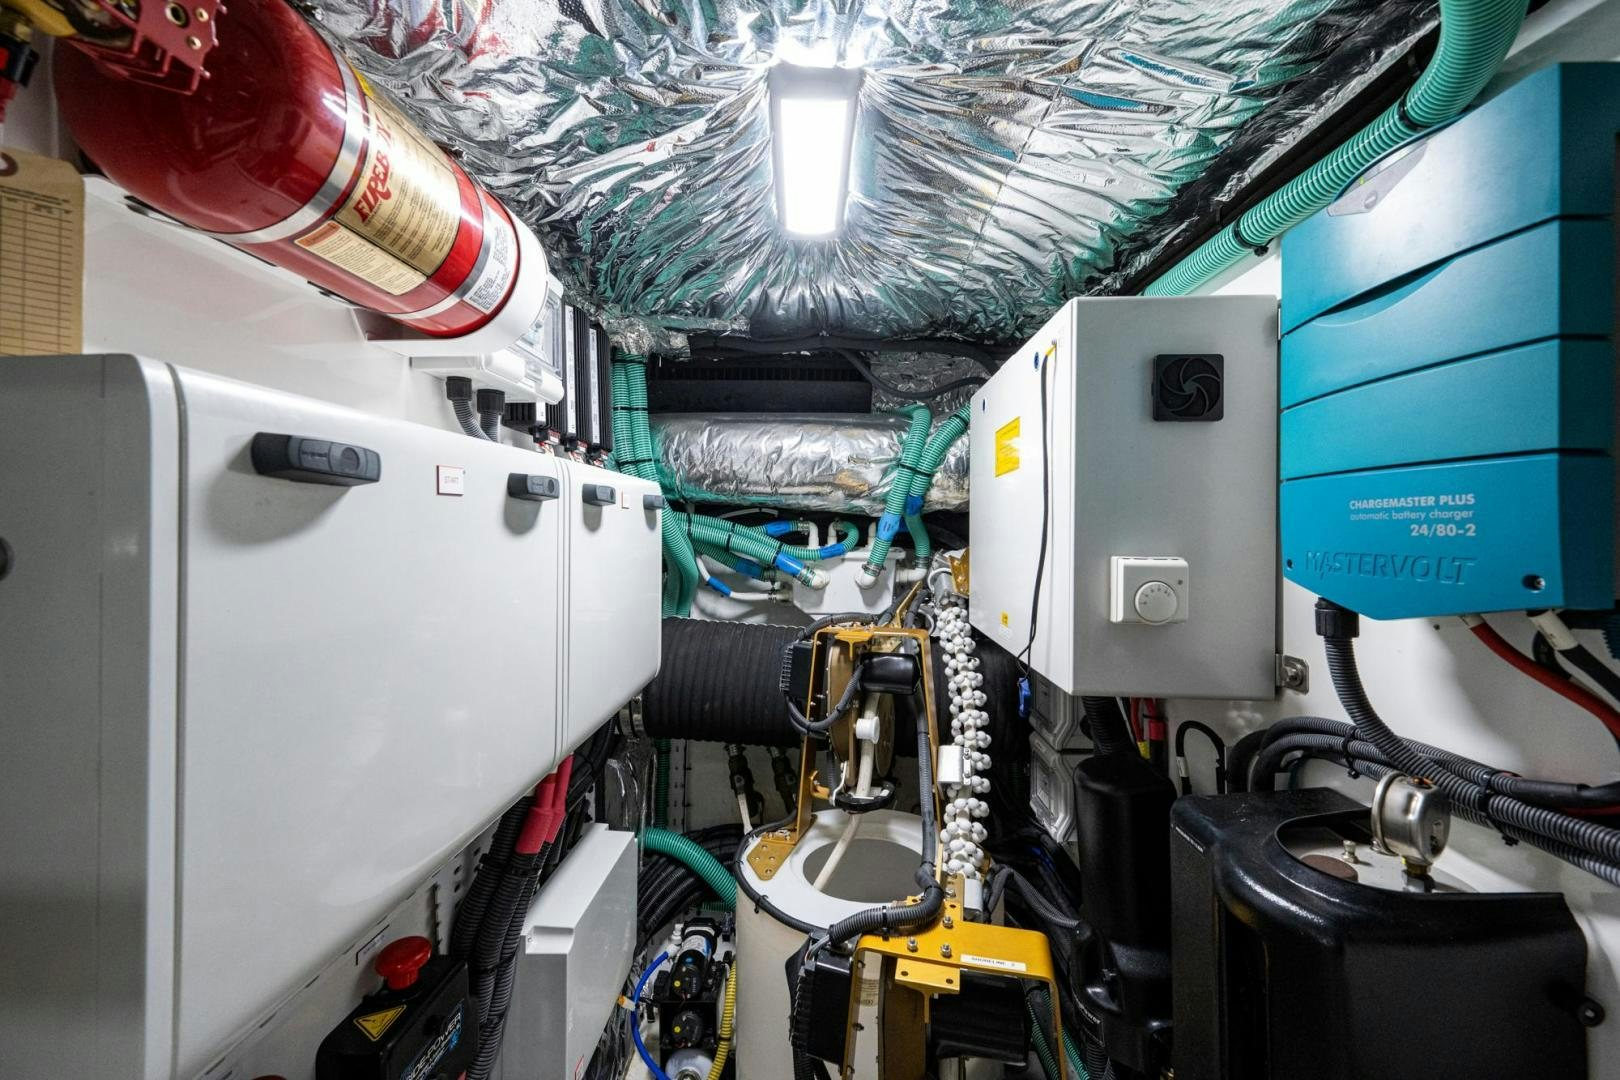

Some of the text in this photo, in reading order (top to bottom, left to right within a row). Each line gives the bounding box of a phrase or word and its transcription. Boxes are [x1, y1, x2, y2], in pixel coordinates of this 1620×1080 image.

[1349, 493, 1475, 510] CHARGEMASTER PLUS
[1350, 508, 1474, 521] automatic battery charger
[1410, 523, 1476, 538] 24/80-2
[1305, 550, 1478, 585] MASTERVOLT
